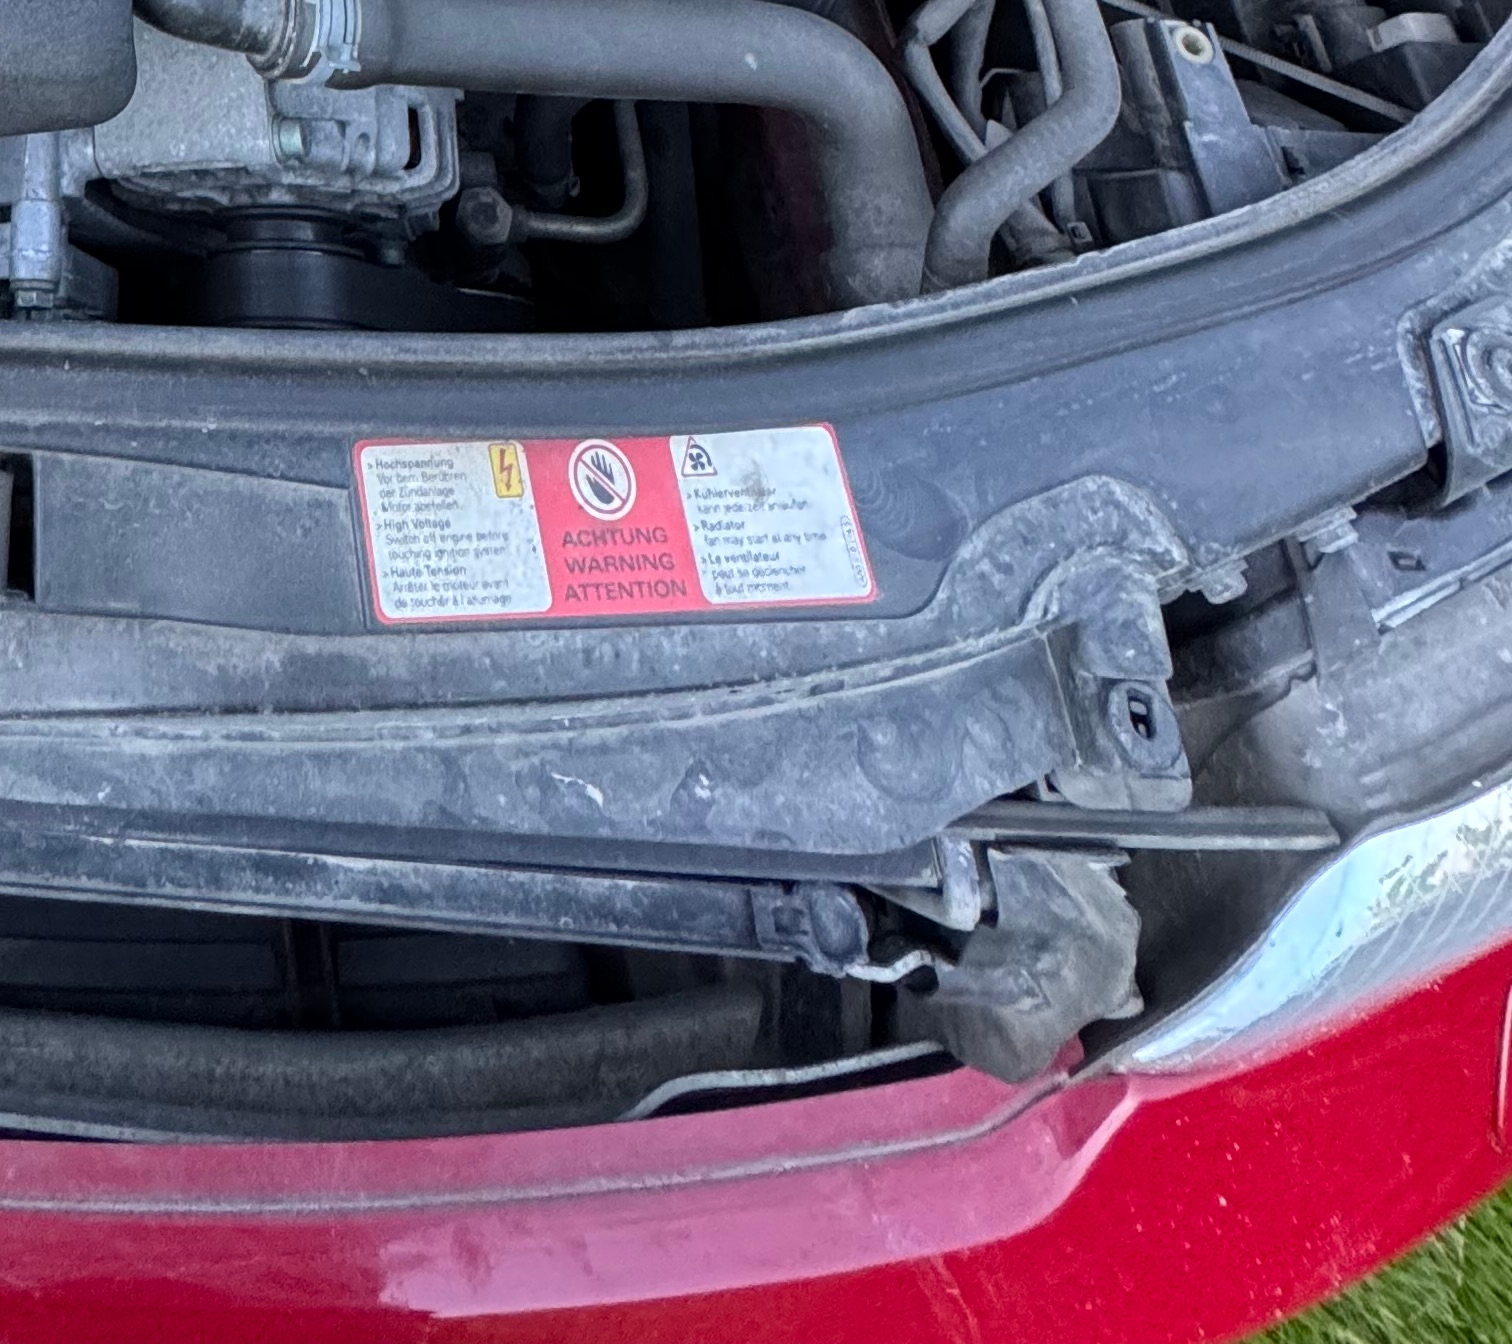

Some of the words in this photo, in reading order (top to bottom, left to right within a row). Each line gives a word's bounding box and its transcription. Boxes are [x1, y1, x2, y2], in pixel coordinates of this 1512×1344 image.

[375, 457, 455, 471] Hochspannung
[379, 487, 396, 500] der
[383, 517, 409, 533] High
[410, 517, 452, 531] Voltage
[700, 519, 745, 533] Radiator
[561, 526, 669, 548] ACHTUNG
[564, 552, 676, 575] WARNING
[707, 552, 721, 565] Le
[390, 566, 423, 579] Haute
[423, 564, 467, 577] Tension
[564, 578, 688, 602] ATTENTION
